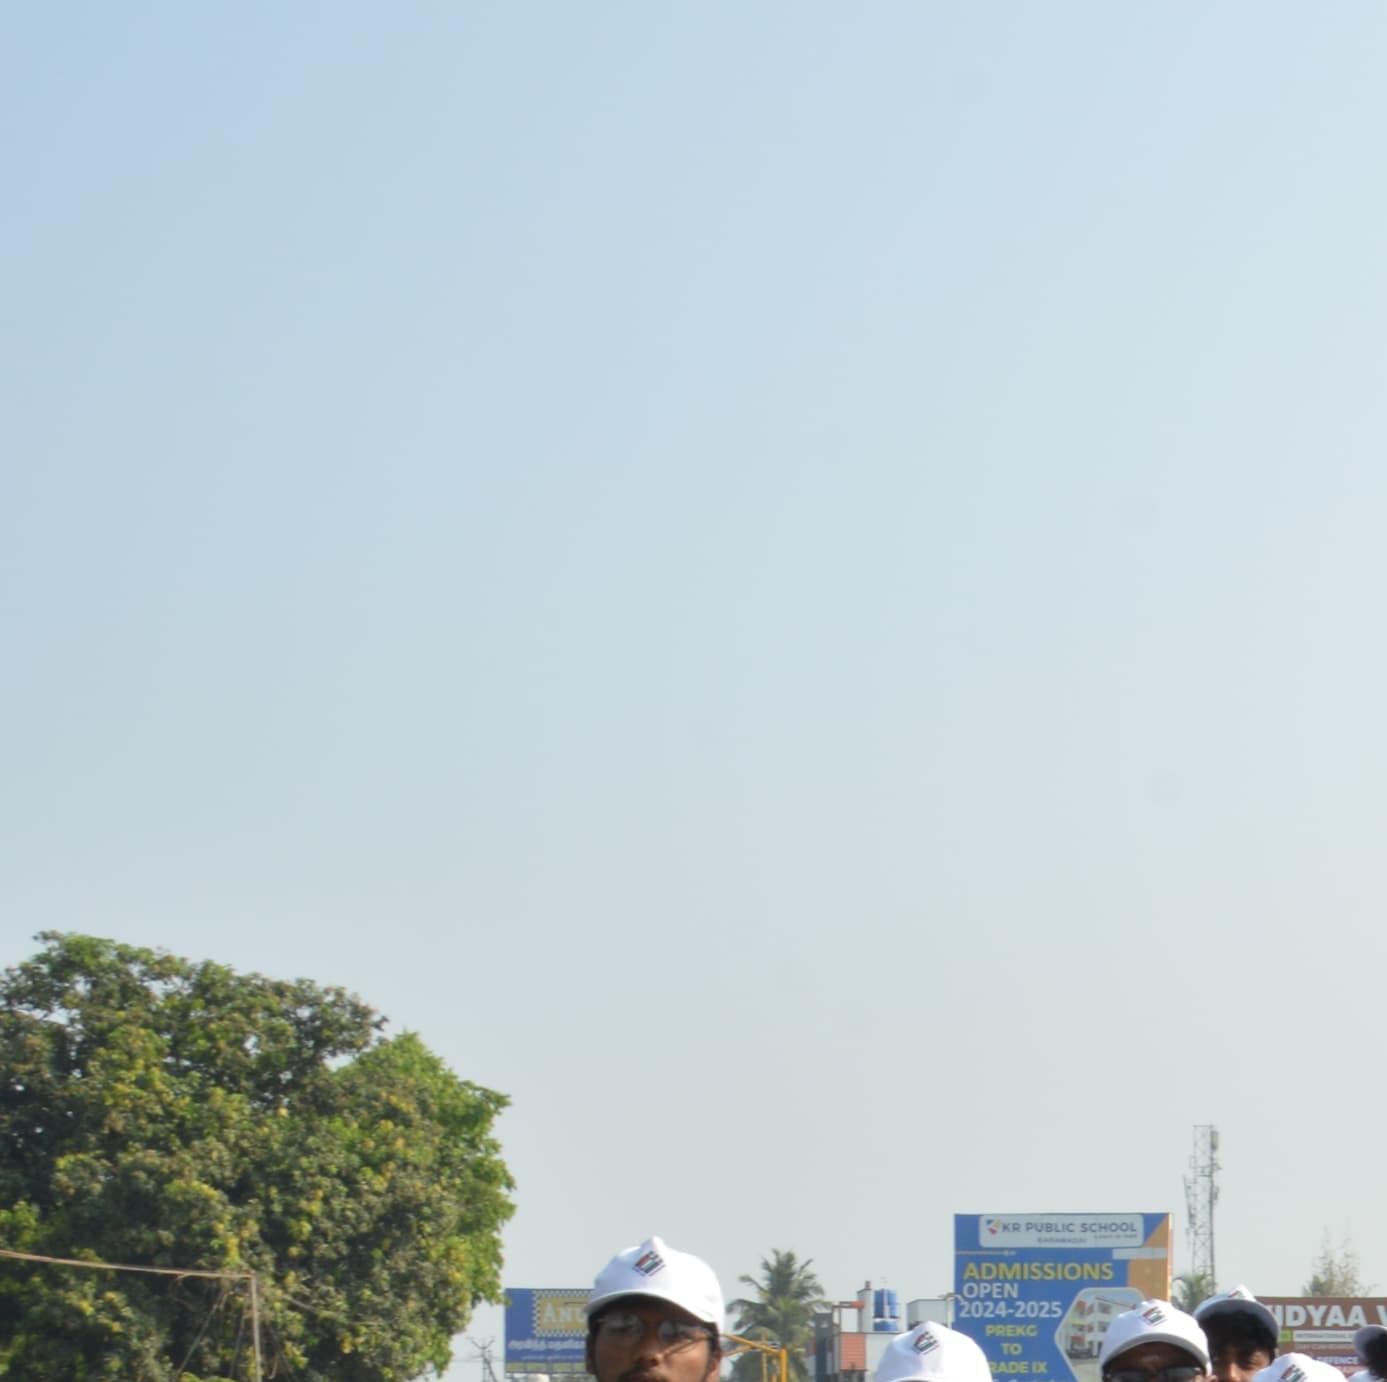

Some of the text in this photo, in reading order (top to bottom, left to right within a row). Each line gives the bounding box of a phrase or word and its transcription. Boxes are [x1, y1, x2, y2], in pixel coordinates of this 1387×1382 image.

[1025, 1222, 1075, 1233] PUBLIC
[1080, 1221, 1137, 1233] SCHOOL
[963, 1262, 1114, 1281] ADMISSIONS
[963, 1282, 1019, 1298] OPEN
[959, 1301, 1062, 1319] 2024-2025
[986, 1325, 1037, 1337] PREKG
[1002, 1343, 1023, 1355] TO
[988, 1361, 1047, 1374] RADE IX
